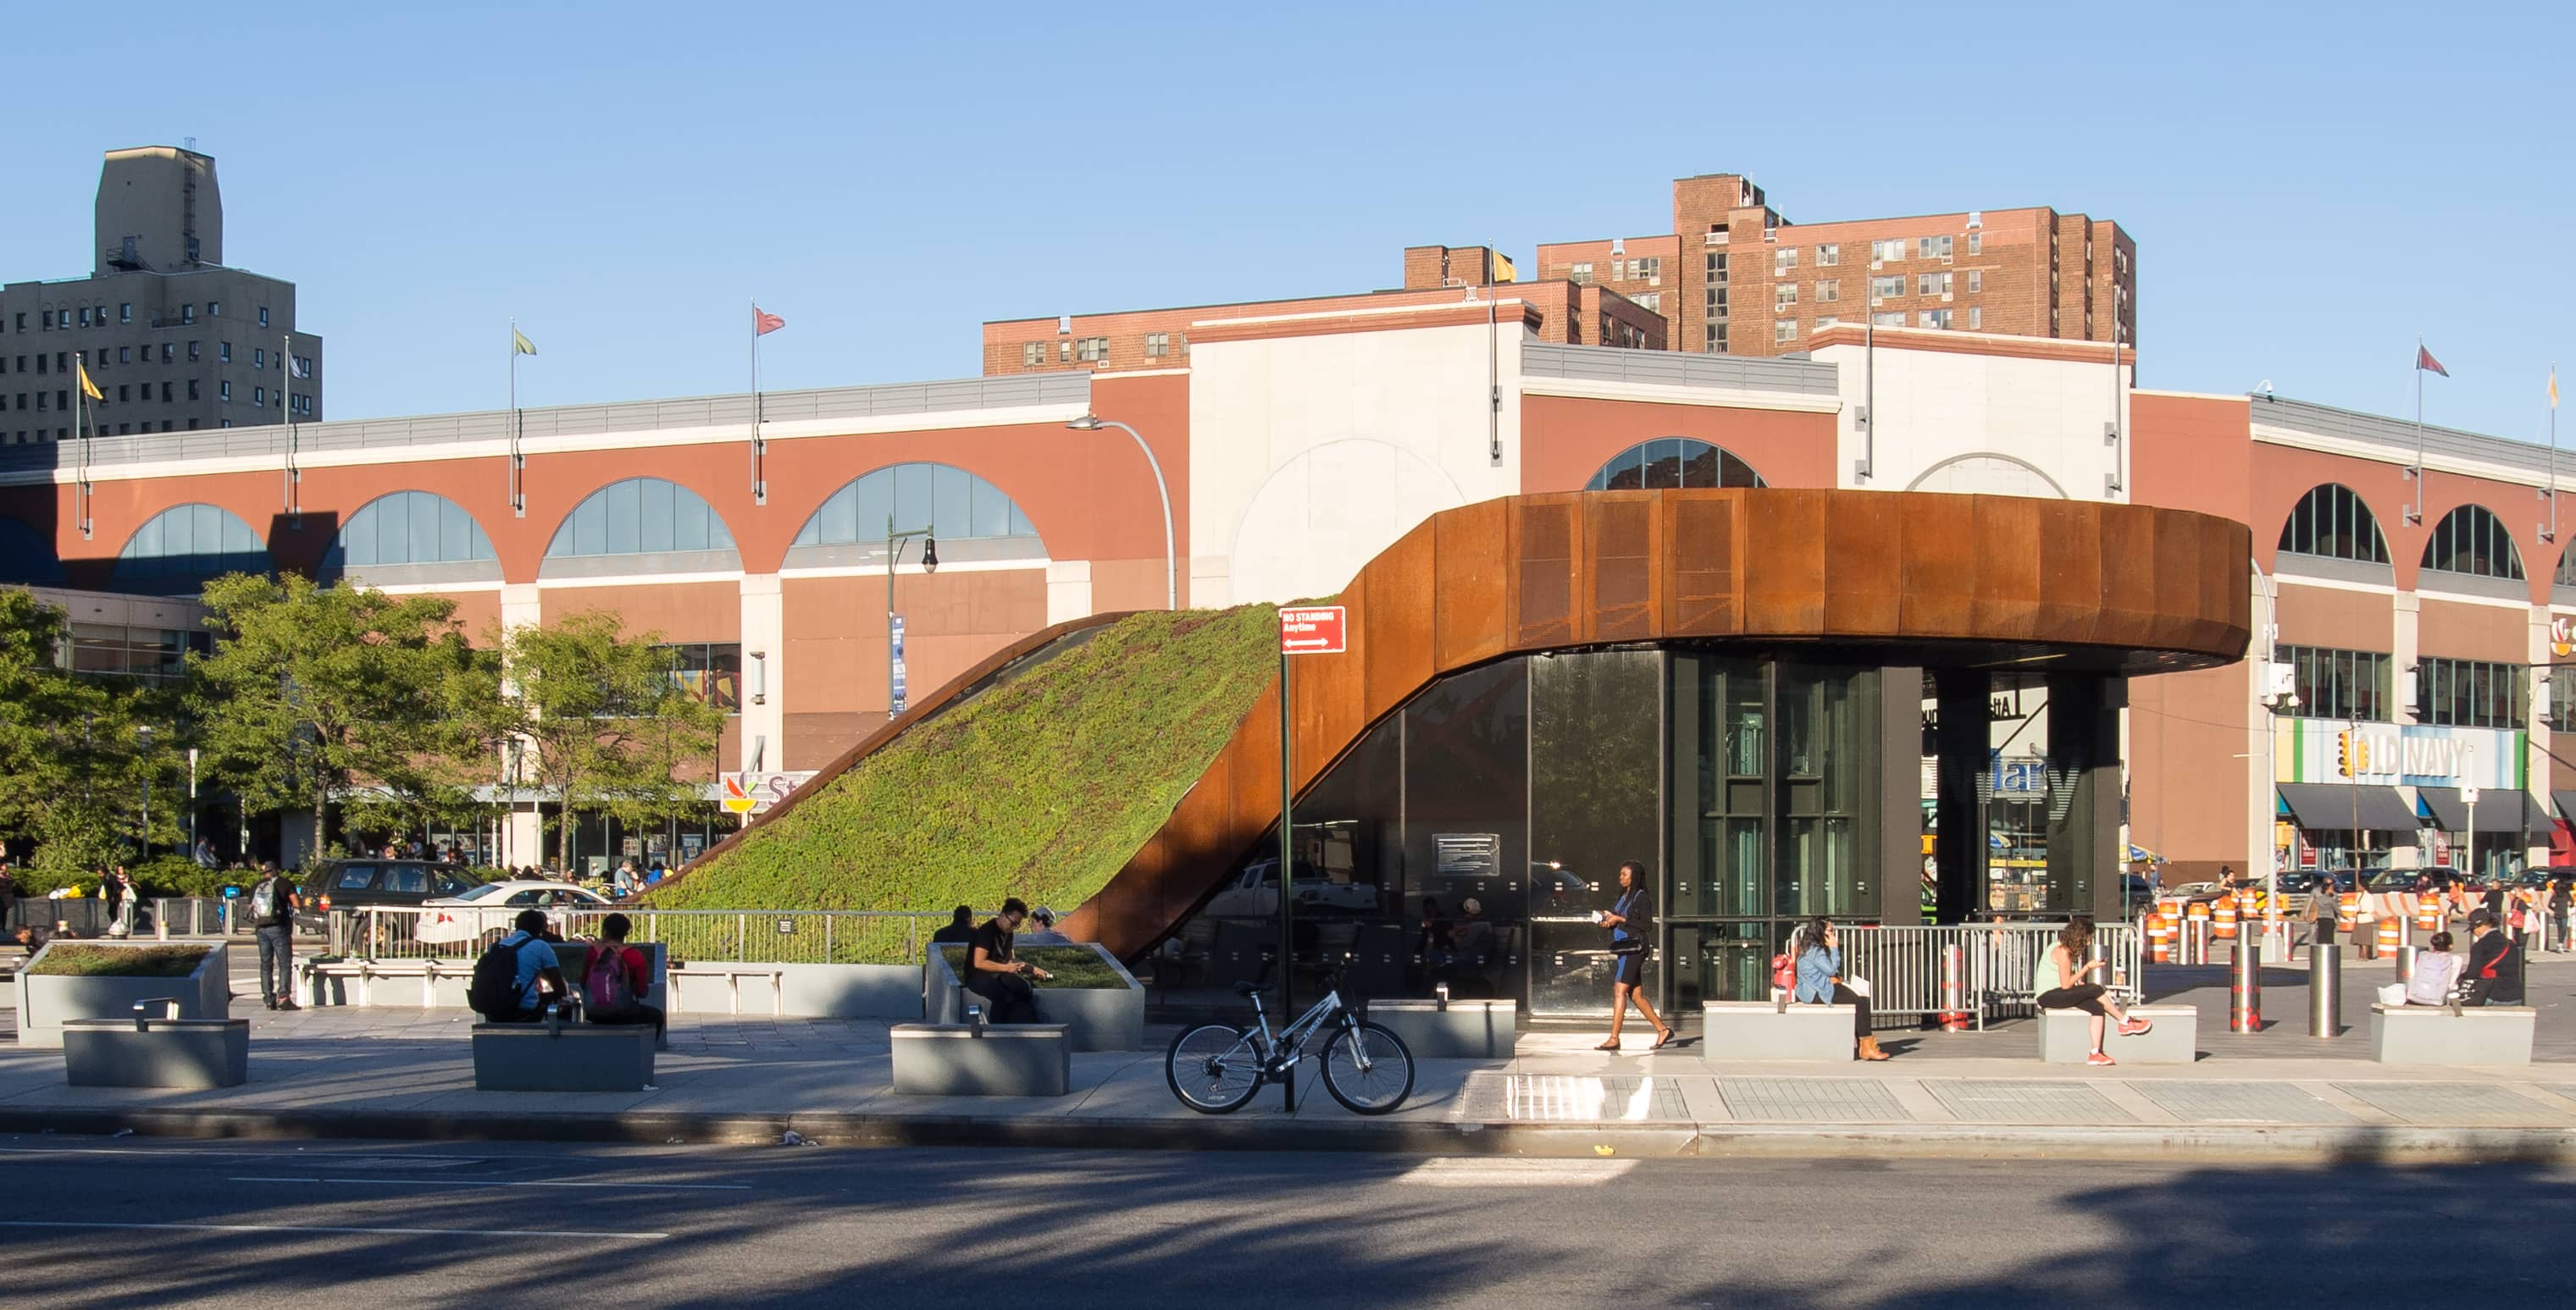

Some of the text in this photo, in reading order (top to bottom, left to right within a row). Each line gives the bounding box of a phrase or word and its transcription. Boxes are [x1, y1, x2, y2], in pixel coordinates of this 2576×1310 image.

[1282, 612, 1334, 622] NO STANDING
[1283, 623, 1316, 633] Anytime
[2403, 736, 2467, 777] NAVY
